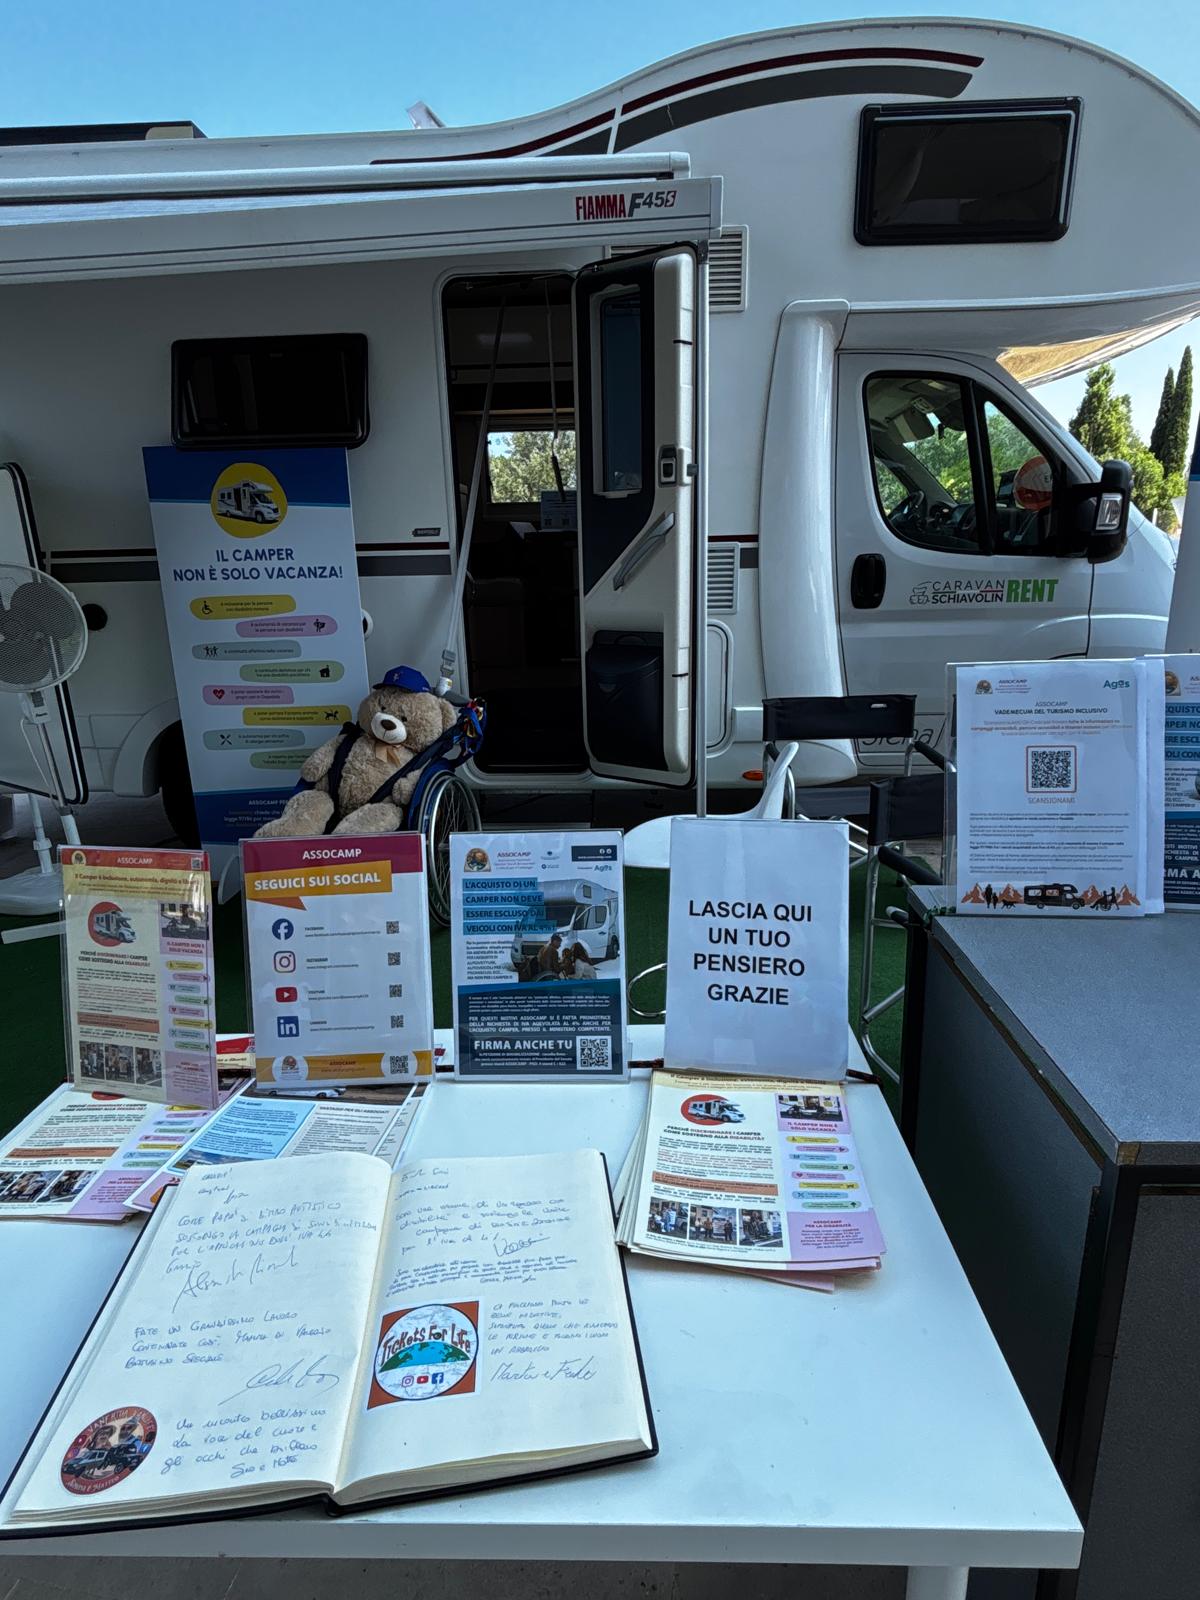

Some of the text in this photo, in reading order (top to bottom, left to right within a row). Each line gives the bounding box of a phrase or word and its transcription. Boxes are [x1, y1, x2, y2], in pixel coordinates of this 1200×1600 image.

[576, 194, 626, 220] FIAMMA
[217, 548, 294, 562] IL CAMPER
[174, 565, 343, 582] NON È SOLO VACANZA!
[932, 580, 1005, 591] CARAVAN
[932, 579, 1059, 604] SCHIAVOLIN RENT
[117, 857, 153, 865] ASSOCAMP
[303, 848, 362, 860] ASSOCAMP
[254, 873, 381, 891] SEGUICI SUI SOCIAL
[466, 880, 536, 889] L'ACQUISTO DI UN
[467, 910, 494, 918] ESSERE
[689, 900, 812, 922] LASCIA QUI
[709, 928, 790, 948] UN TUO
[694, 953, 805, 977] PENSIERO
[707, 984, 789, 1005] GRAZIE
[474, 1040, 573, 1050] FIRMA ANCHE TU
